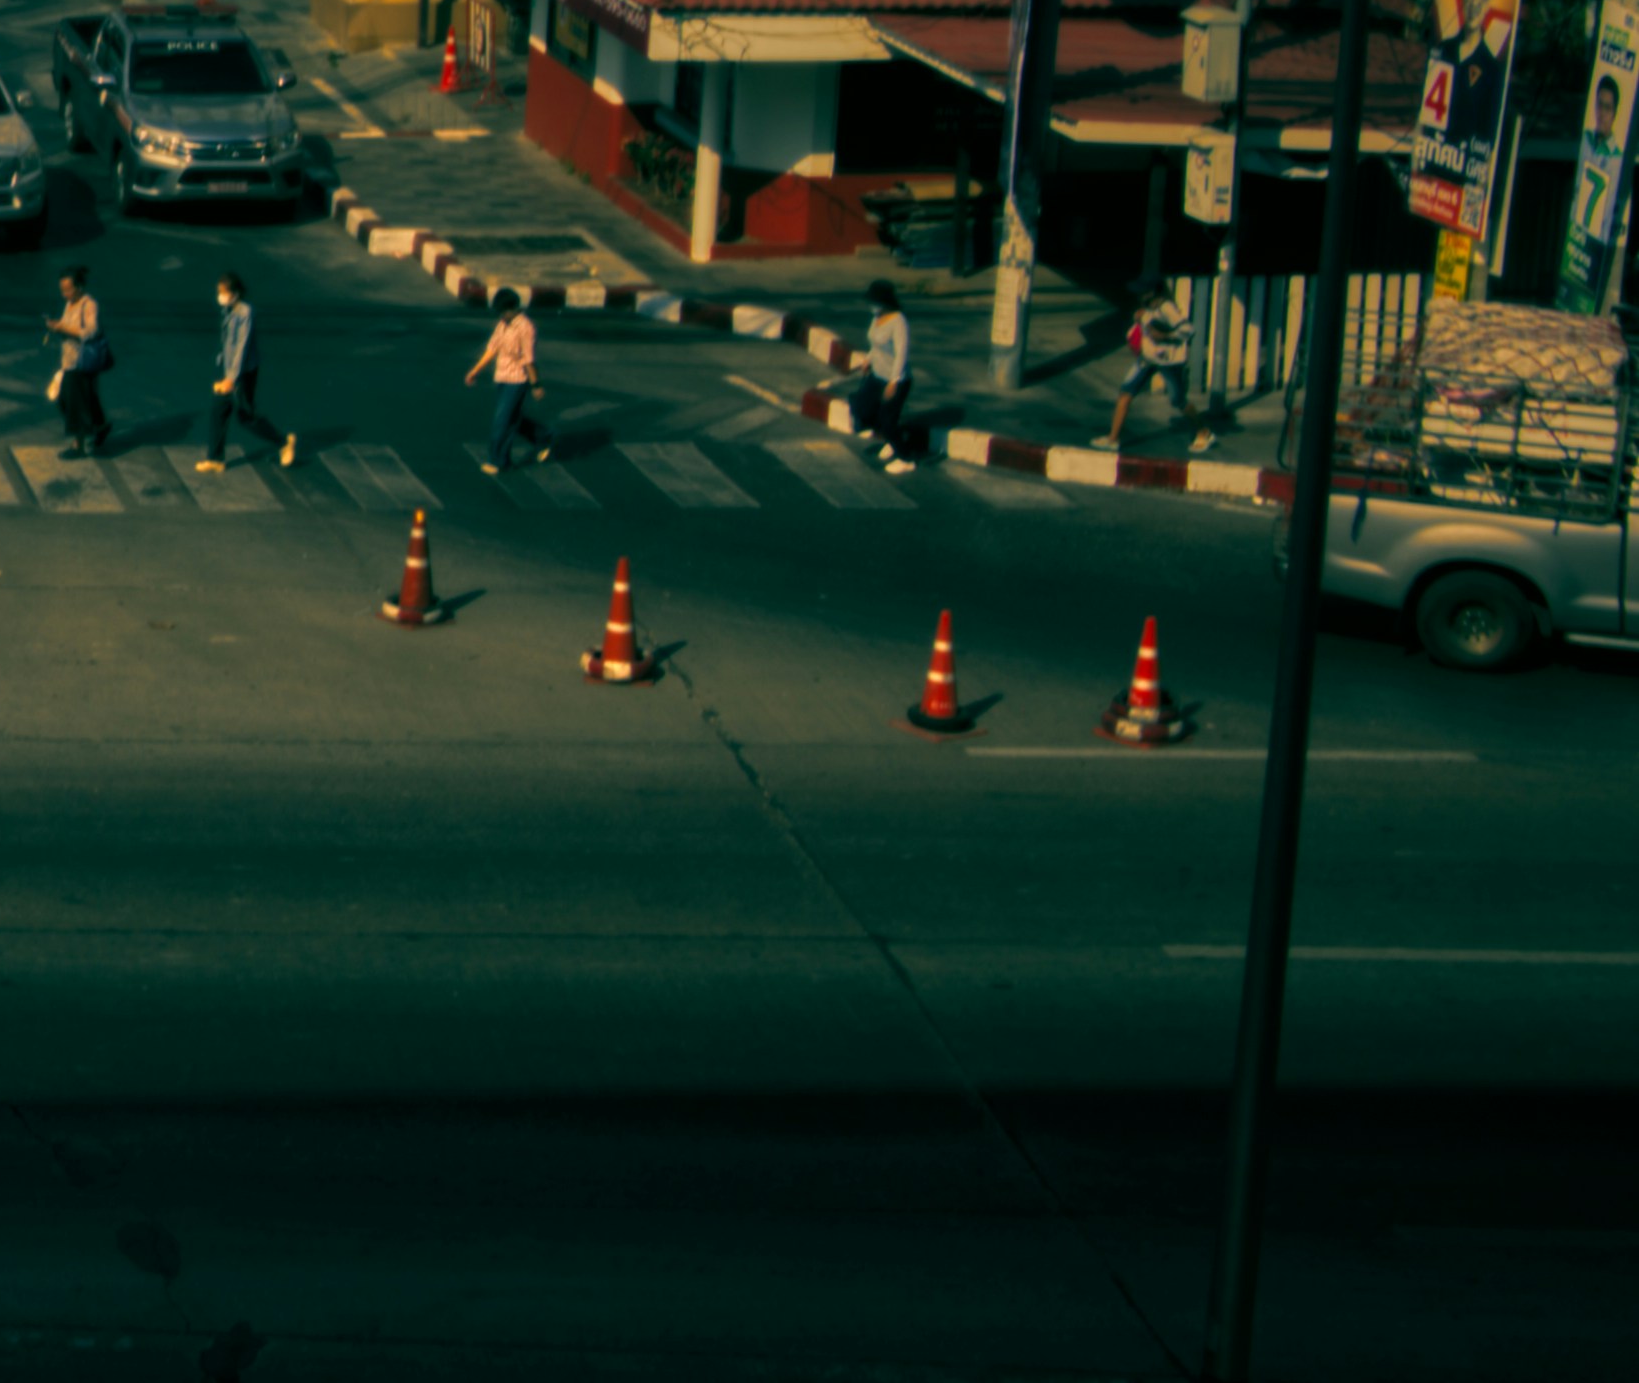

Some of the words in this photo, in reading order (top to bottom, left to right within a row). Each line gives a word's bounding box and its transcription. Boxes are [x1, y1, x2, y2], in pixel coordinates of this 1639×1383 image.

[167, 38, 219, 52] POLICE
[1424, 70, 1449, 122] 4
[1584, 165, 1607, 228] 7
